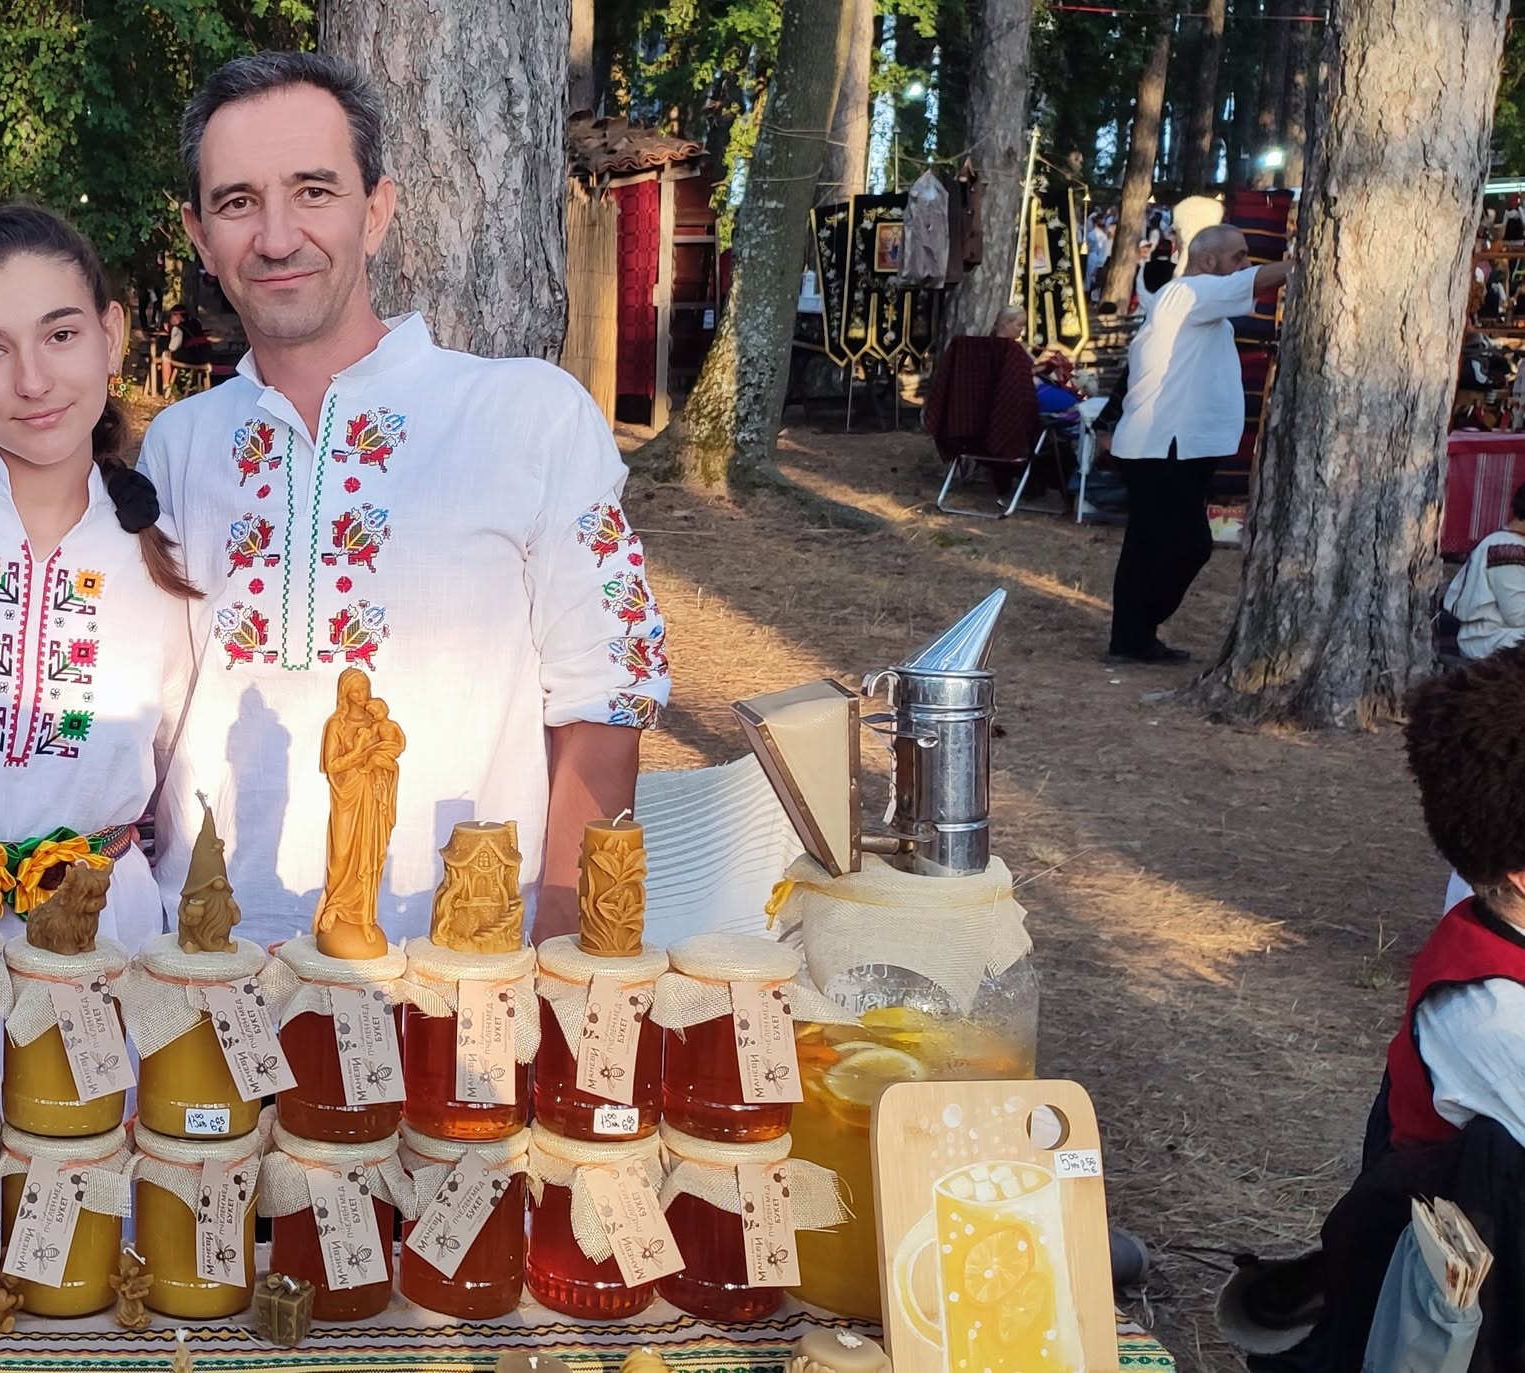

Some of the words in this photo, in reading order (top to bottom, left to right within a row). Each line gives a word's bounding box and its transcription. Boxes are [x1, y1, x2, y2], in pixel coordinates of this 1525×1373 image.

[235, 998, 246, 1016] МЕД
[248, 1010, 262, 1034] БУКЕТ
[362, 1004, 370, 1021] МЕД
[486, 1003, 494, 1021] МЕД
[240, 1017, 256, 1048] ПЧЕЛЕН
[364, 1022, 374, 1056] ПЧЕЛЕН
[372, 1017, 382, 1042] БУКЕТ
[484, 1022, 493, 1054] ПЧЕЛЕН
[494, 1017, 502, 1042] БУКЕТ
[237, 1052, 262, 1094] МАНЕВИ
[352, 1058, 368, 1101] МАНЕВИ
[467, 1053, 478, 1097] МАНЕВИ
[338, 1186, 346, 1204] МЕД
[452, 1193, 474, 1224] ПЧЕЛЕН
[470, 1180, 485, 1199] МЕД
[466, 1196, 484, 1219] БУКЕТ
[341, 1205, 354, 1238] ПЧЕЛЕН
[349, 1198, 360, 1224] БУКЕТ
[418, 1212, 446, 1252] МАНЕВИ
[206, 1232, 215, 1275] МАНЕВИ
[332, 1241, 349, 1285] МАНЕВИ
